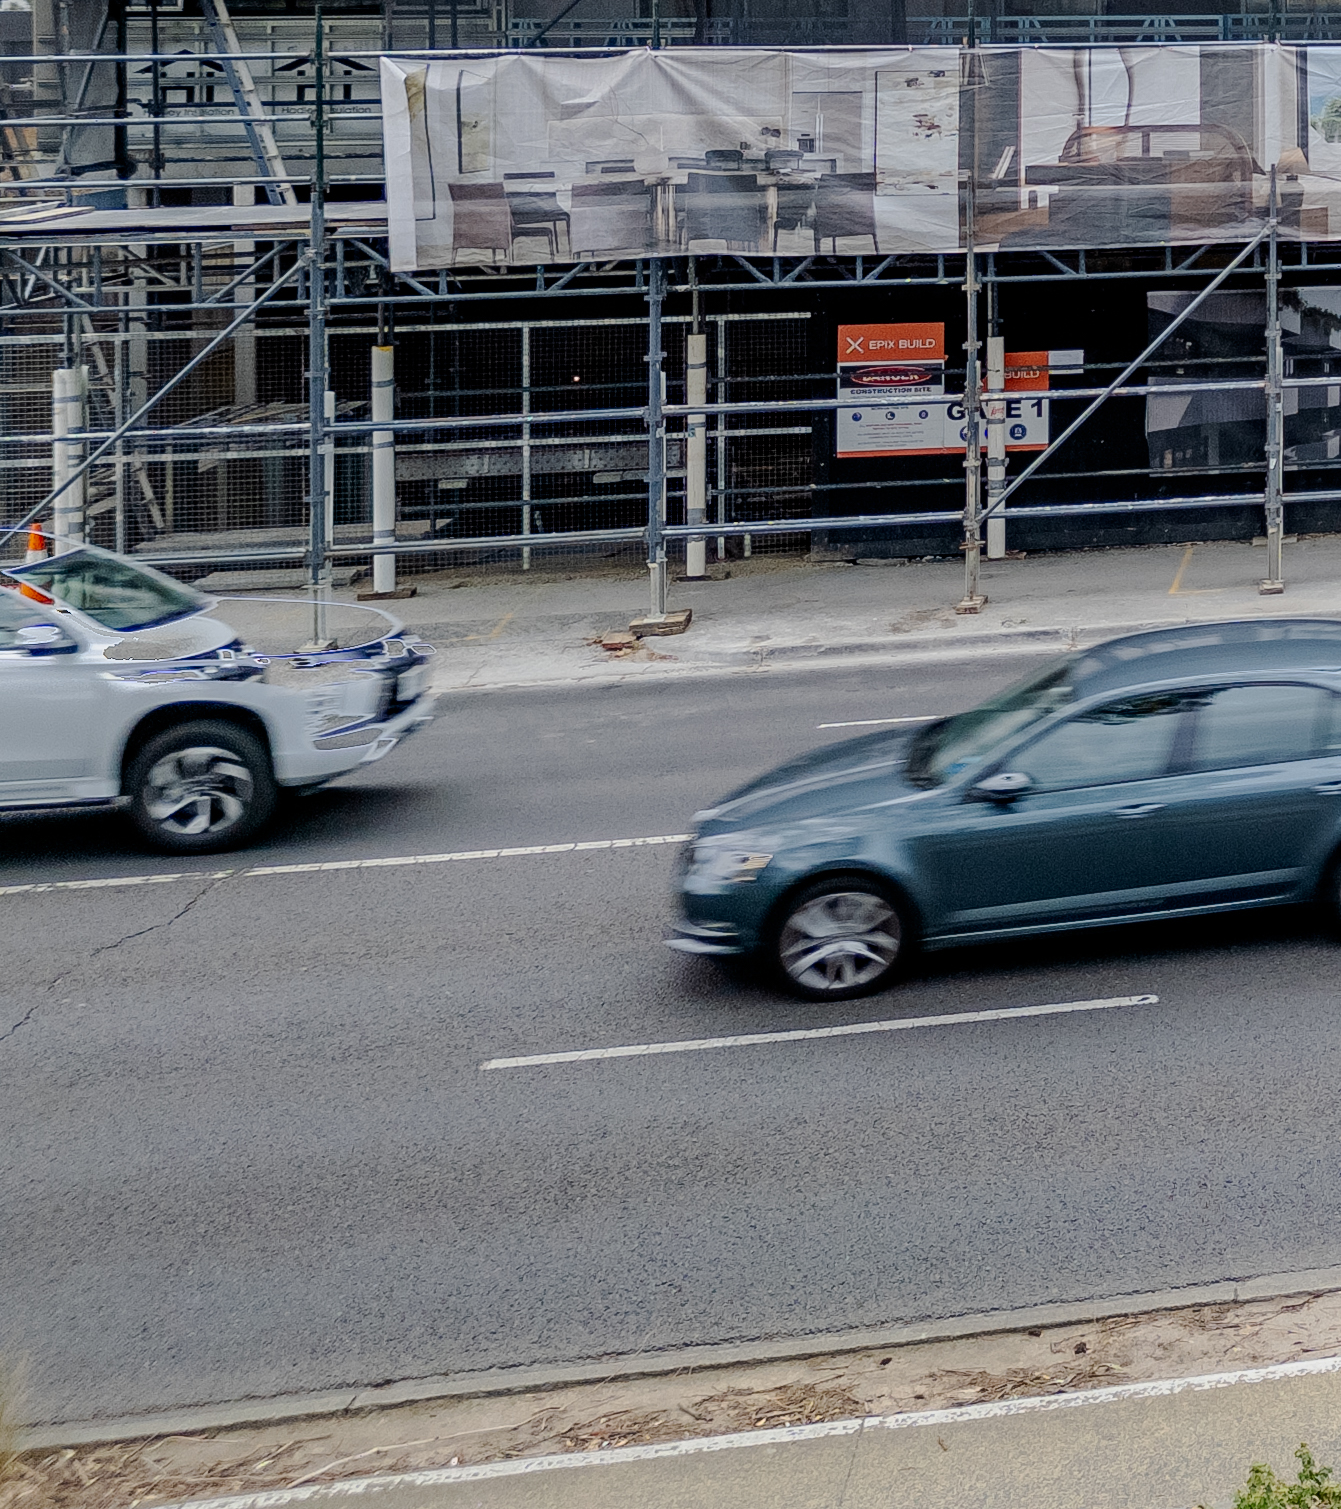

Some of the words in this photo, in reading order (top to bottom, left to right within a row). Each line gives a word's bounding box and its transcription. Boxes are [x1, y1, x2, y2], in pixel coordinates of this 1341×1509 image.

[868, 340, 895, 350] EPIX
[898, 338, 936, 349] BUILD
[850, 387, 913, 395] CONSTRUCTION
[947, 399, 1022, 420] GE
[1030, 398, 1043, 418] 1
